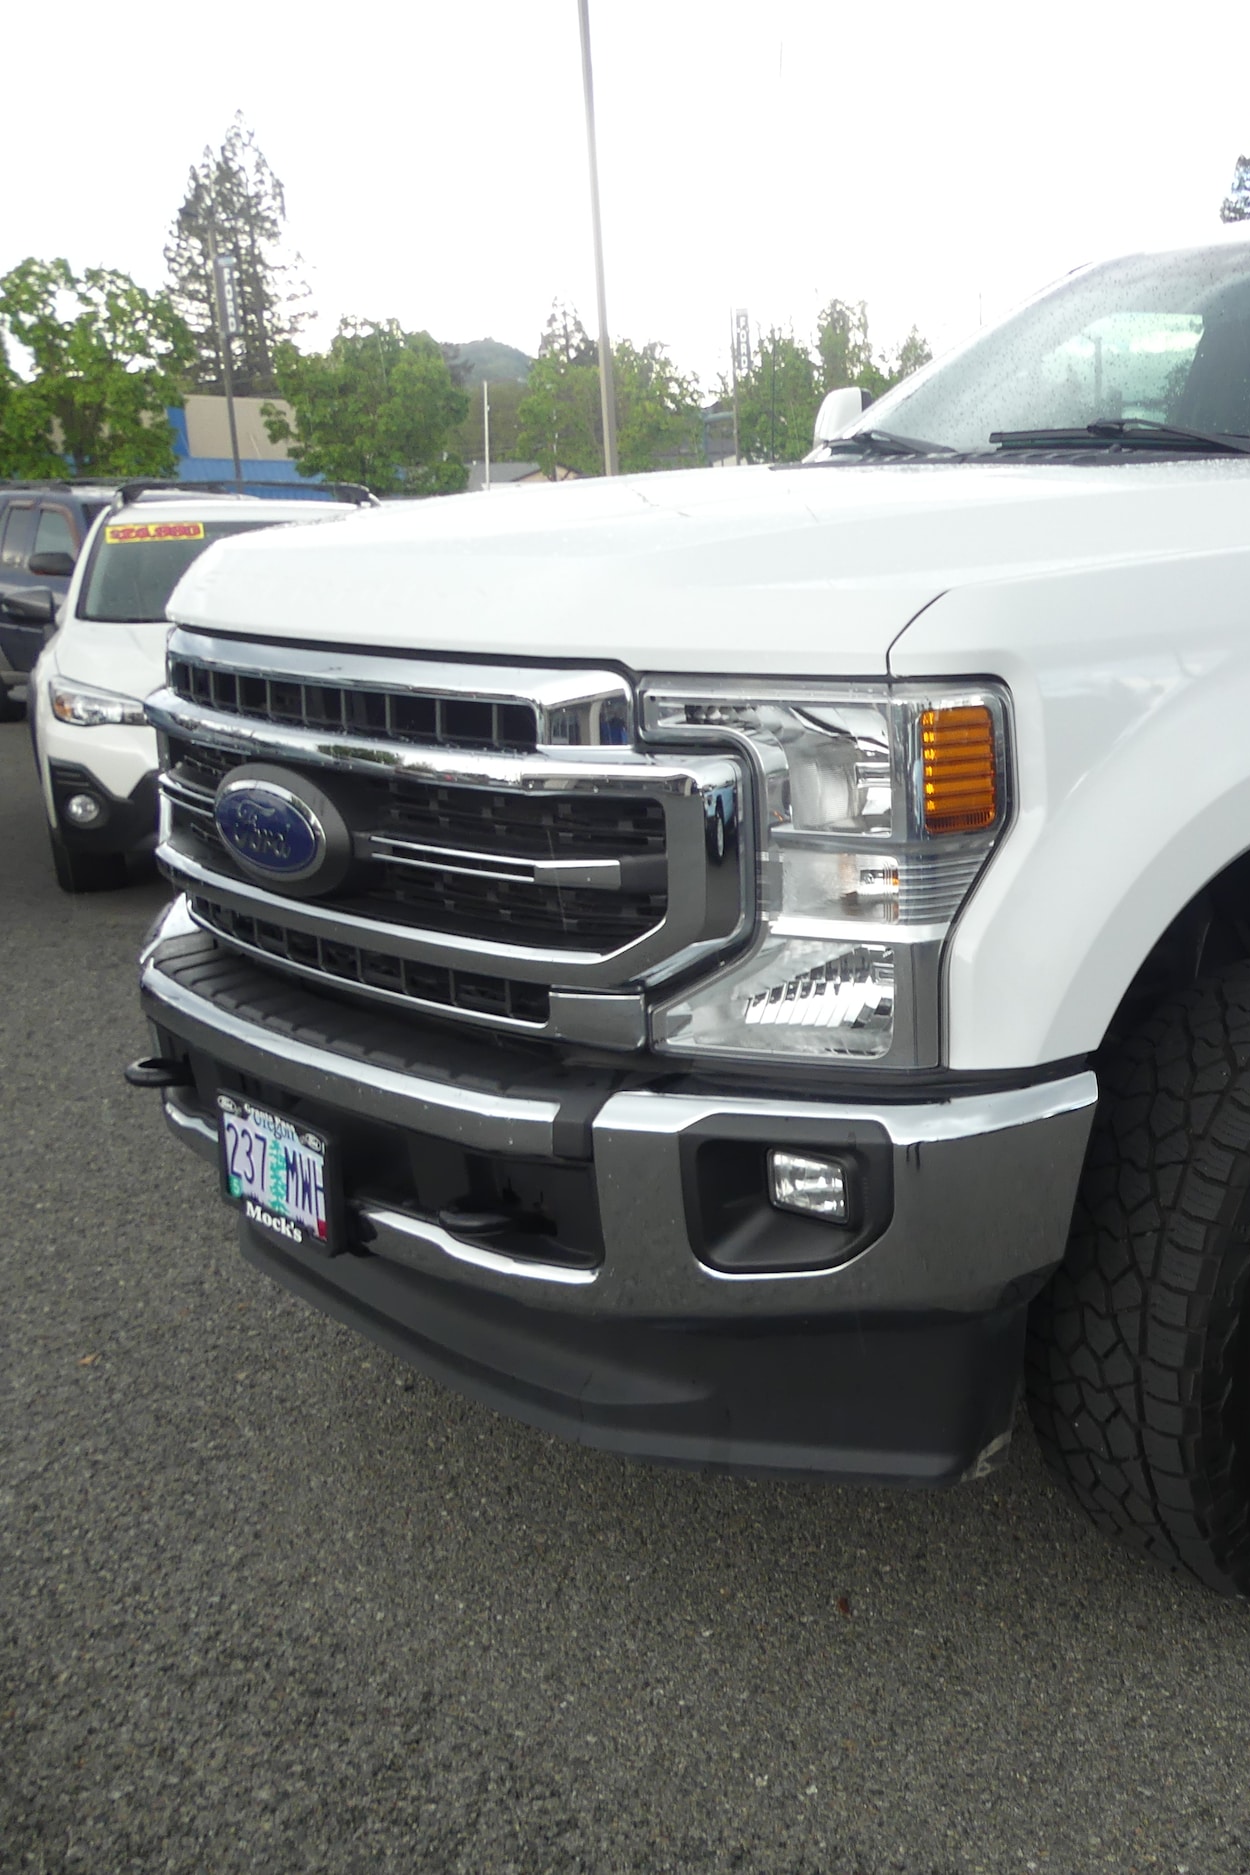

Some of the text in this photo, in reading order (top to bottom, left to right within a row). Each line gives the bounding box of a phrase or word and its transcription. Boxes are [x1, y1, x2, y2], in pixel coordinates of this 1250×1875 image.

[232, 799, 291, 859] Ford
[226, 1123, 267, 1192] 237
[246, 1200, 303, 1243] Mock's
